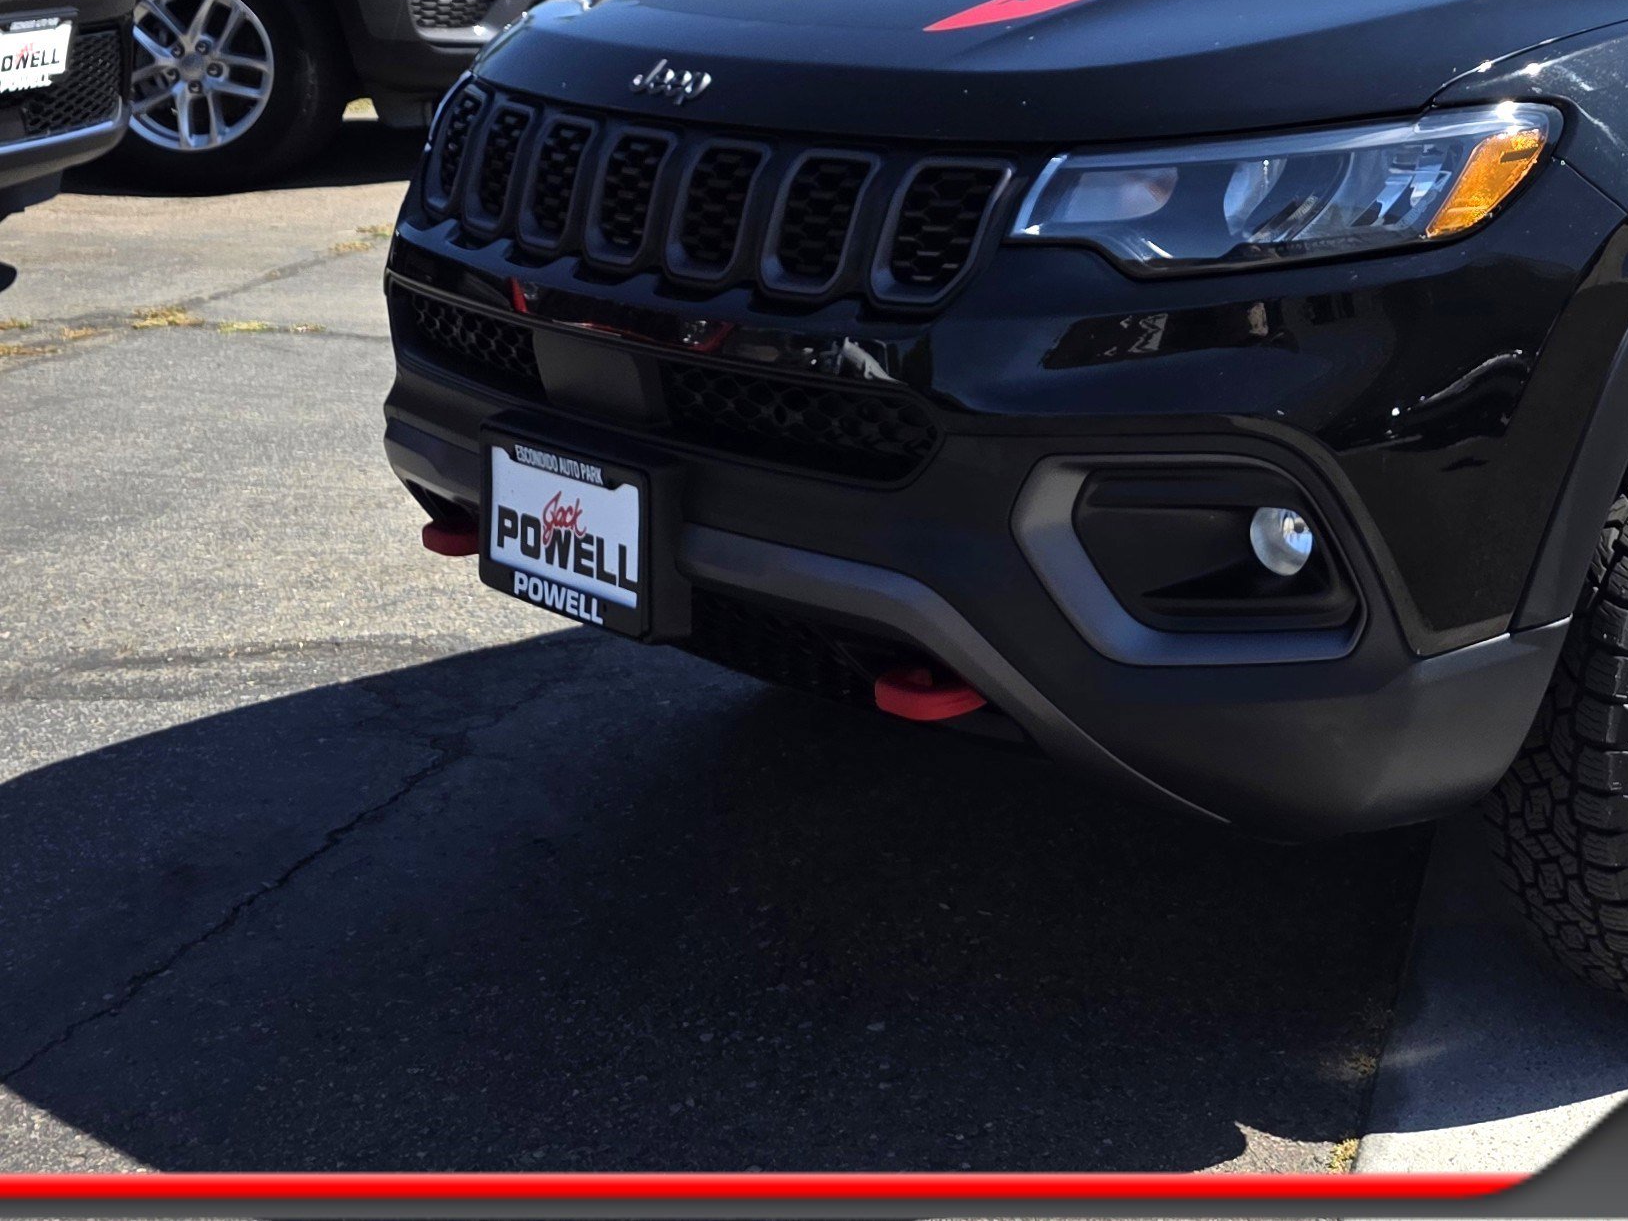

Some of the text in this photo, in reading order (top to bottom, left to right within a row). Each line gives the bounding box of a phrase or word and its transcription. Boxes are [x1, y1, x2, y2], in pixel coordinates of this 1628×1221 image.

[0, 47, 60, 73] OWELL
[629, 58, 712, 105] Jeep
[514, 443, 604, 485] ESCONDIDO AUTO PARK
[542, 490, 587, 546] Jack
[497, 504, 638, 595] POWELL
[513, 570, 603, 625] POWELL
